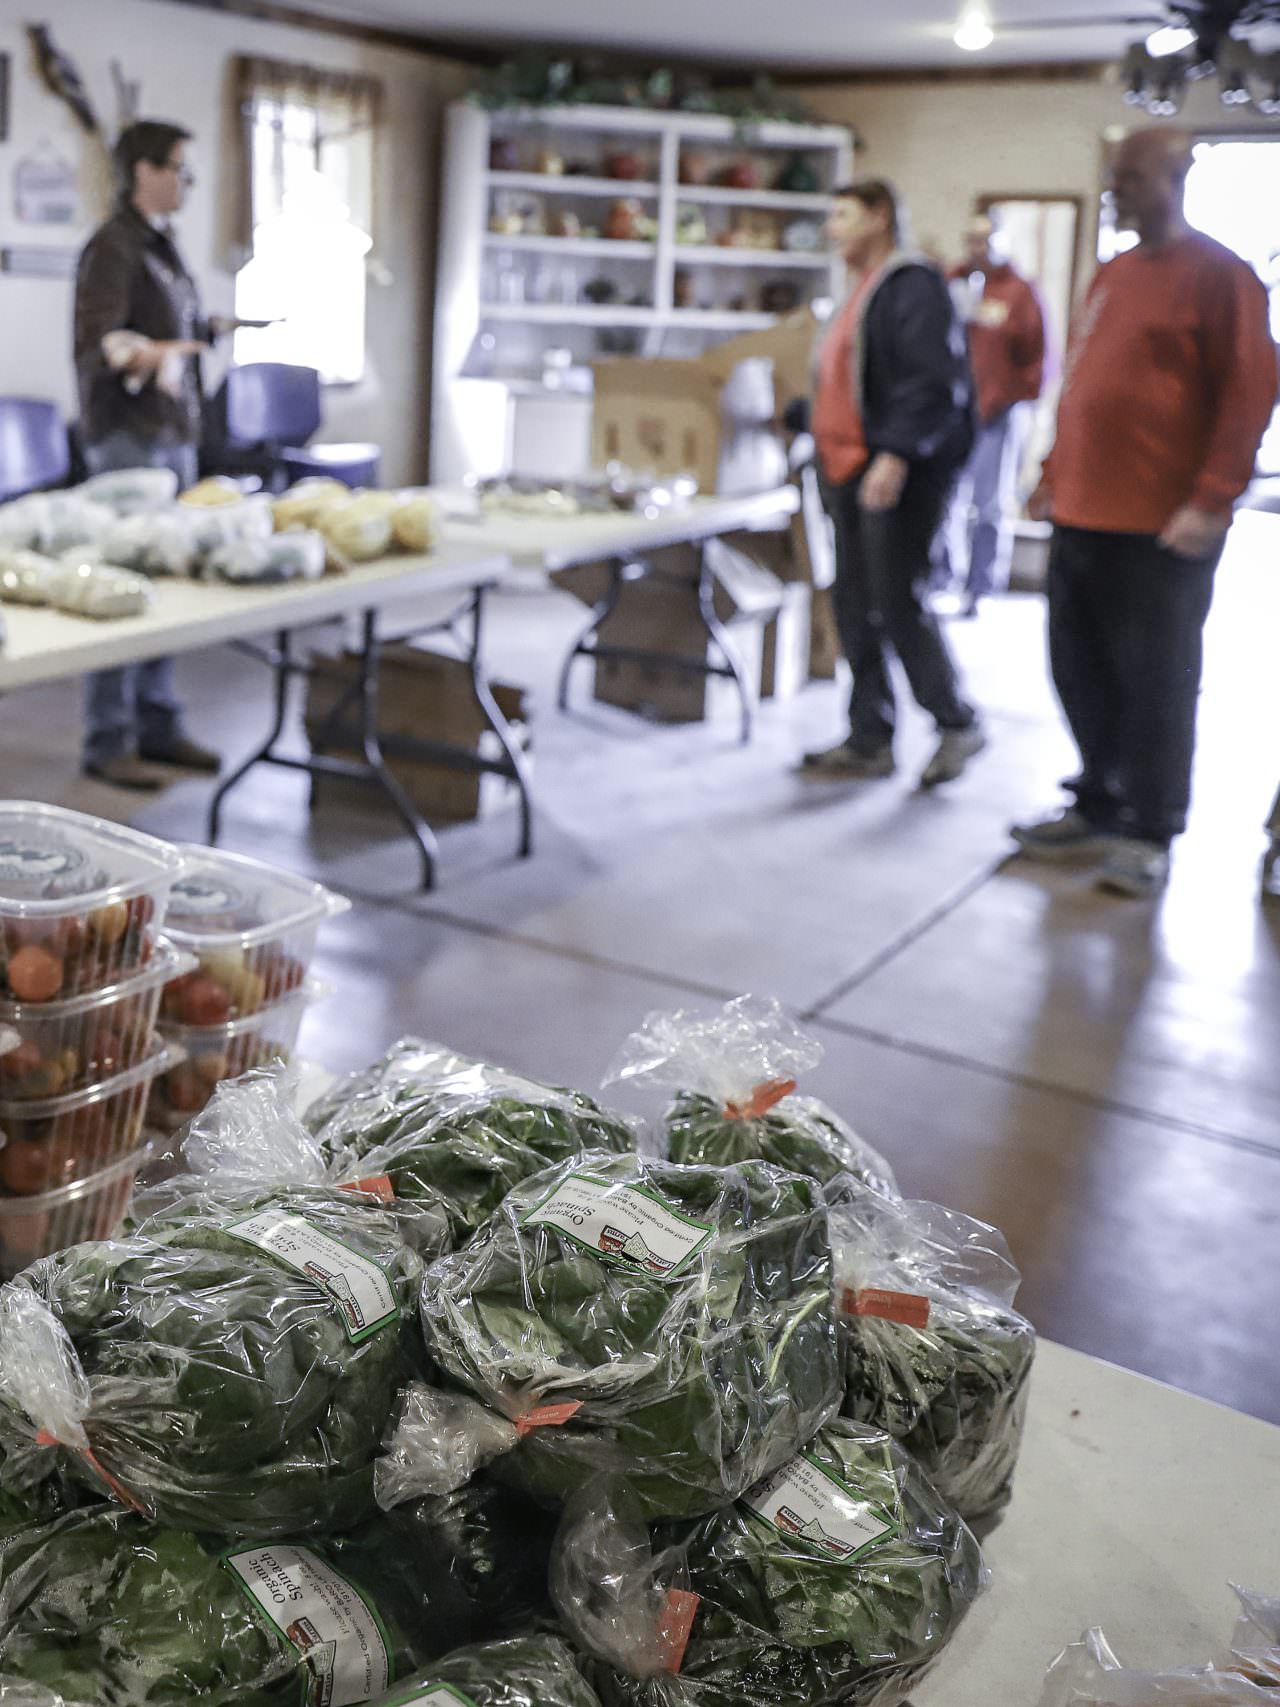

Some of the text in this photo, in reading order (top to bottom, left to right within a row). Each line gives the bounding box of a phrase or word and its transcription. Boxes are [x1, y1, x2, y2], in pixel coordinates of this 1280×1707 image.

[543, 1209, 584, 1226] Organic
[546, 1201, 596, 1217] Spinach
[637, 1209, 664, 1232] Organic
[246, 1228, 289, 1252] Orgnic
[249, 1223, 300, 1251] Spiach
[664, 1226, 694, 1244] Certified
[248, 1559, 286, 1604] Organic
[261, 1552, 304, 1601] Spinach
[329, 1606, 351, 1635] Please
[349, 1617, 369, 1651] Organic
